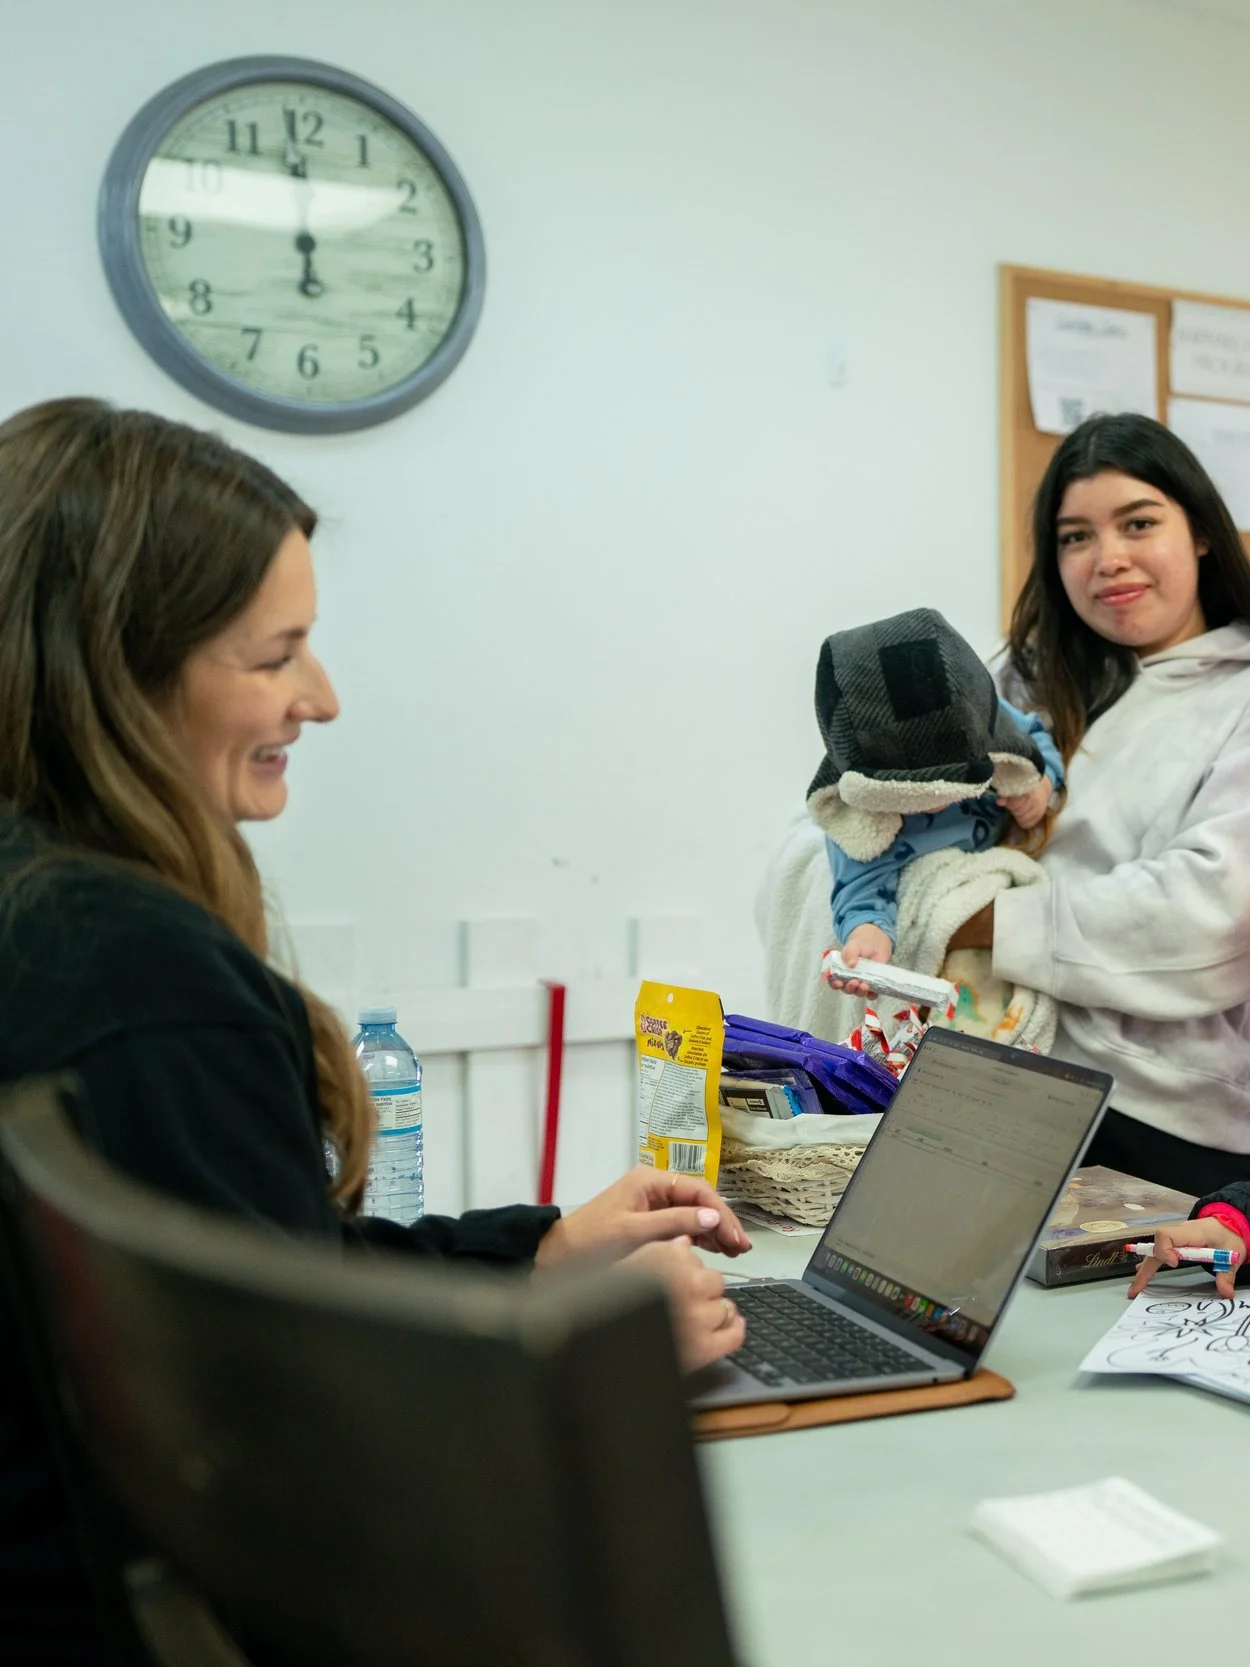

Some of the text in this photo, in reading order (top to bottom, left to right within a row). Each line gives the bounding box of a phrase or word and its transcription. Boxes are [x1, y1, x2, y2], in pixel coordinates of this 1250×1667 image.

[225, 119, 260, 155] 11
[285, 109, 325, 147] 12
[353, 134, 371, 168] 1
[184, 157, 223, 195] 10
[396, 180, 418, 216] 2
[168, 217, 192, 249] 9
[412, 240, 435, 273] 3
[188, 279, 214, 316] 8
[395, 297, 418, 331] 4
[241, 328, 264, 362] 7
[297, 343, 320, 380] 6
[357, 335, 380, 369] 5
